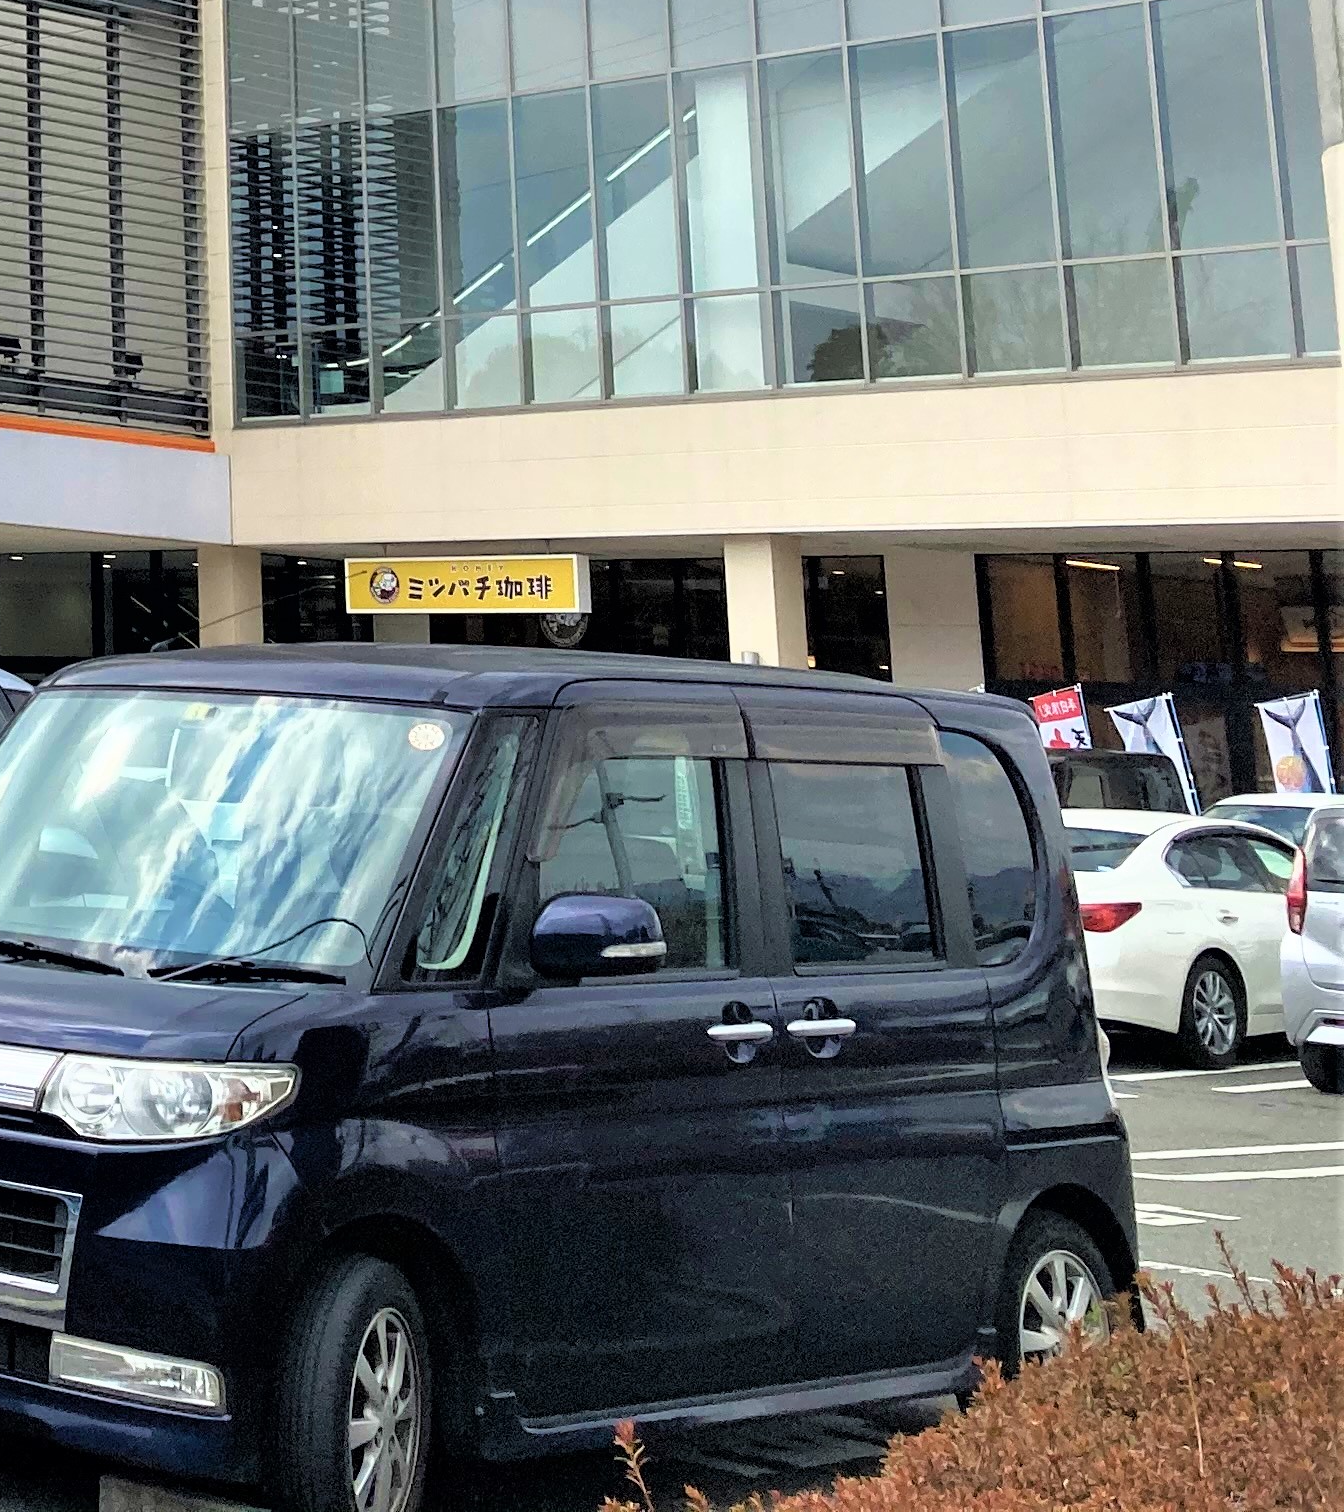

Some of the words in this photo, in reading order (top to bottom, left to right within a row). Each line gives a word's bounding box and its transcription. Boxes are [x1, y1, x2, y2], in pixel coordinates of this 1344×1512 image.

[408, 575, 553, 600] ミツバチ珈琲
